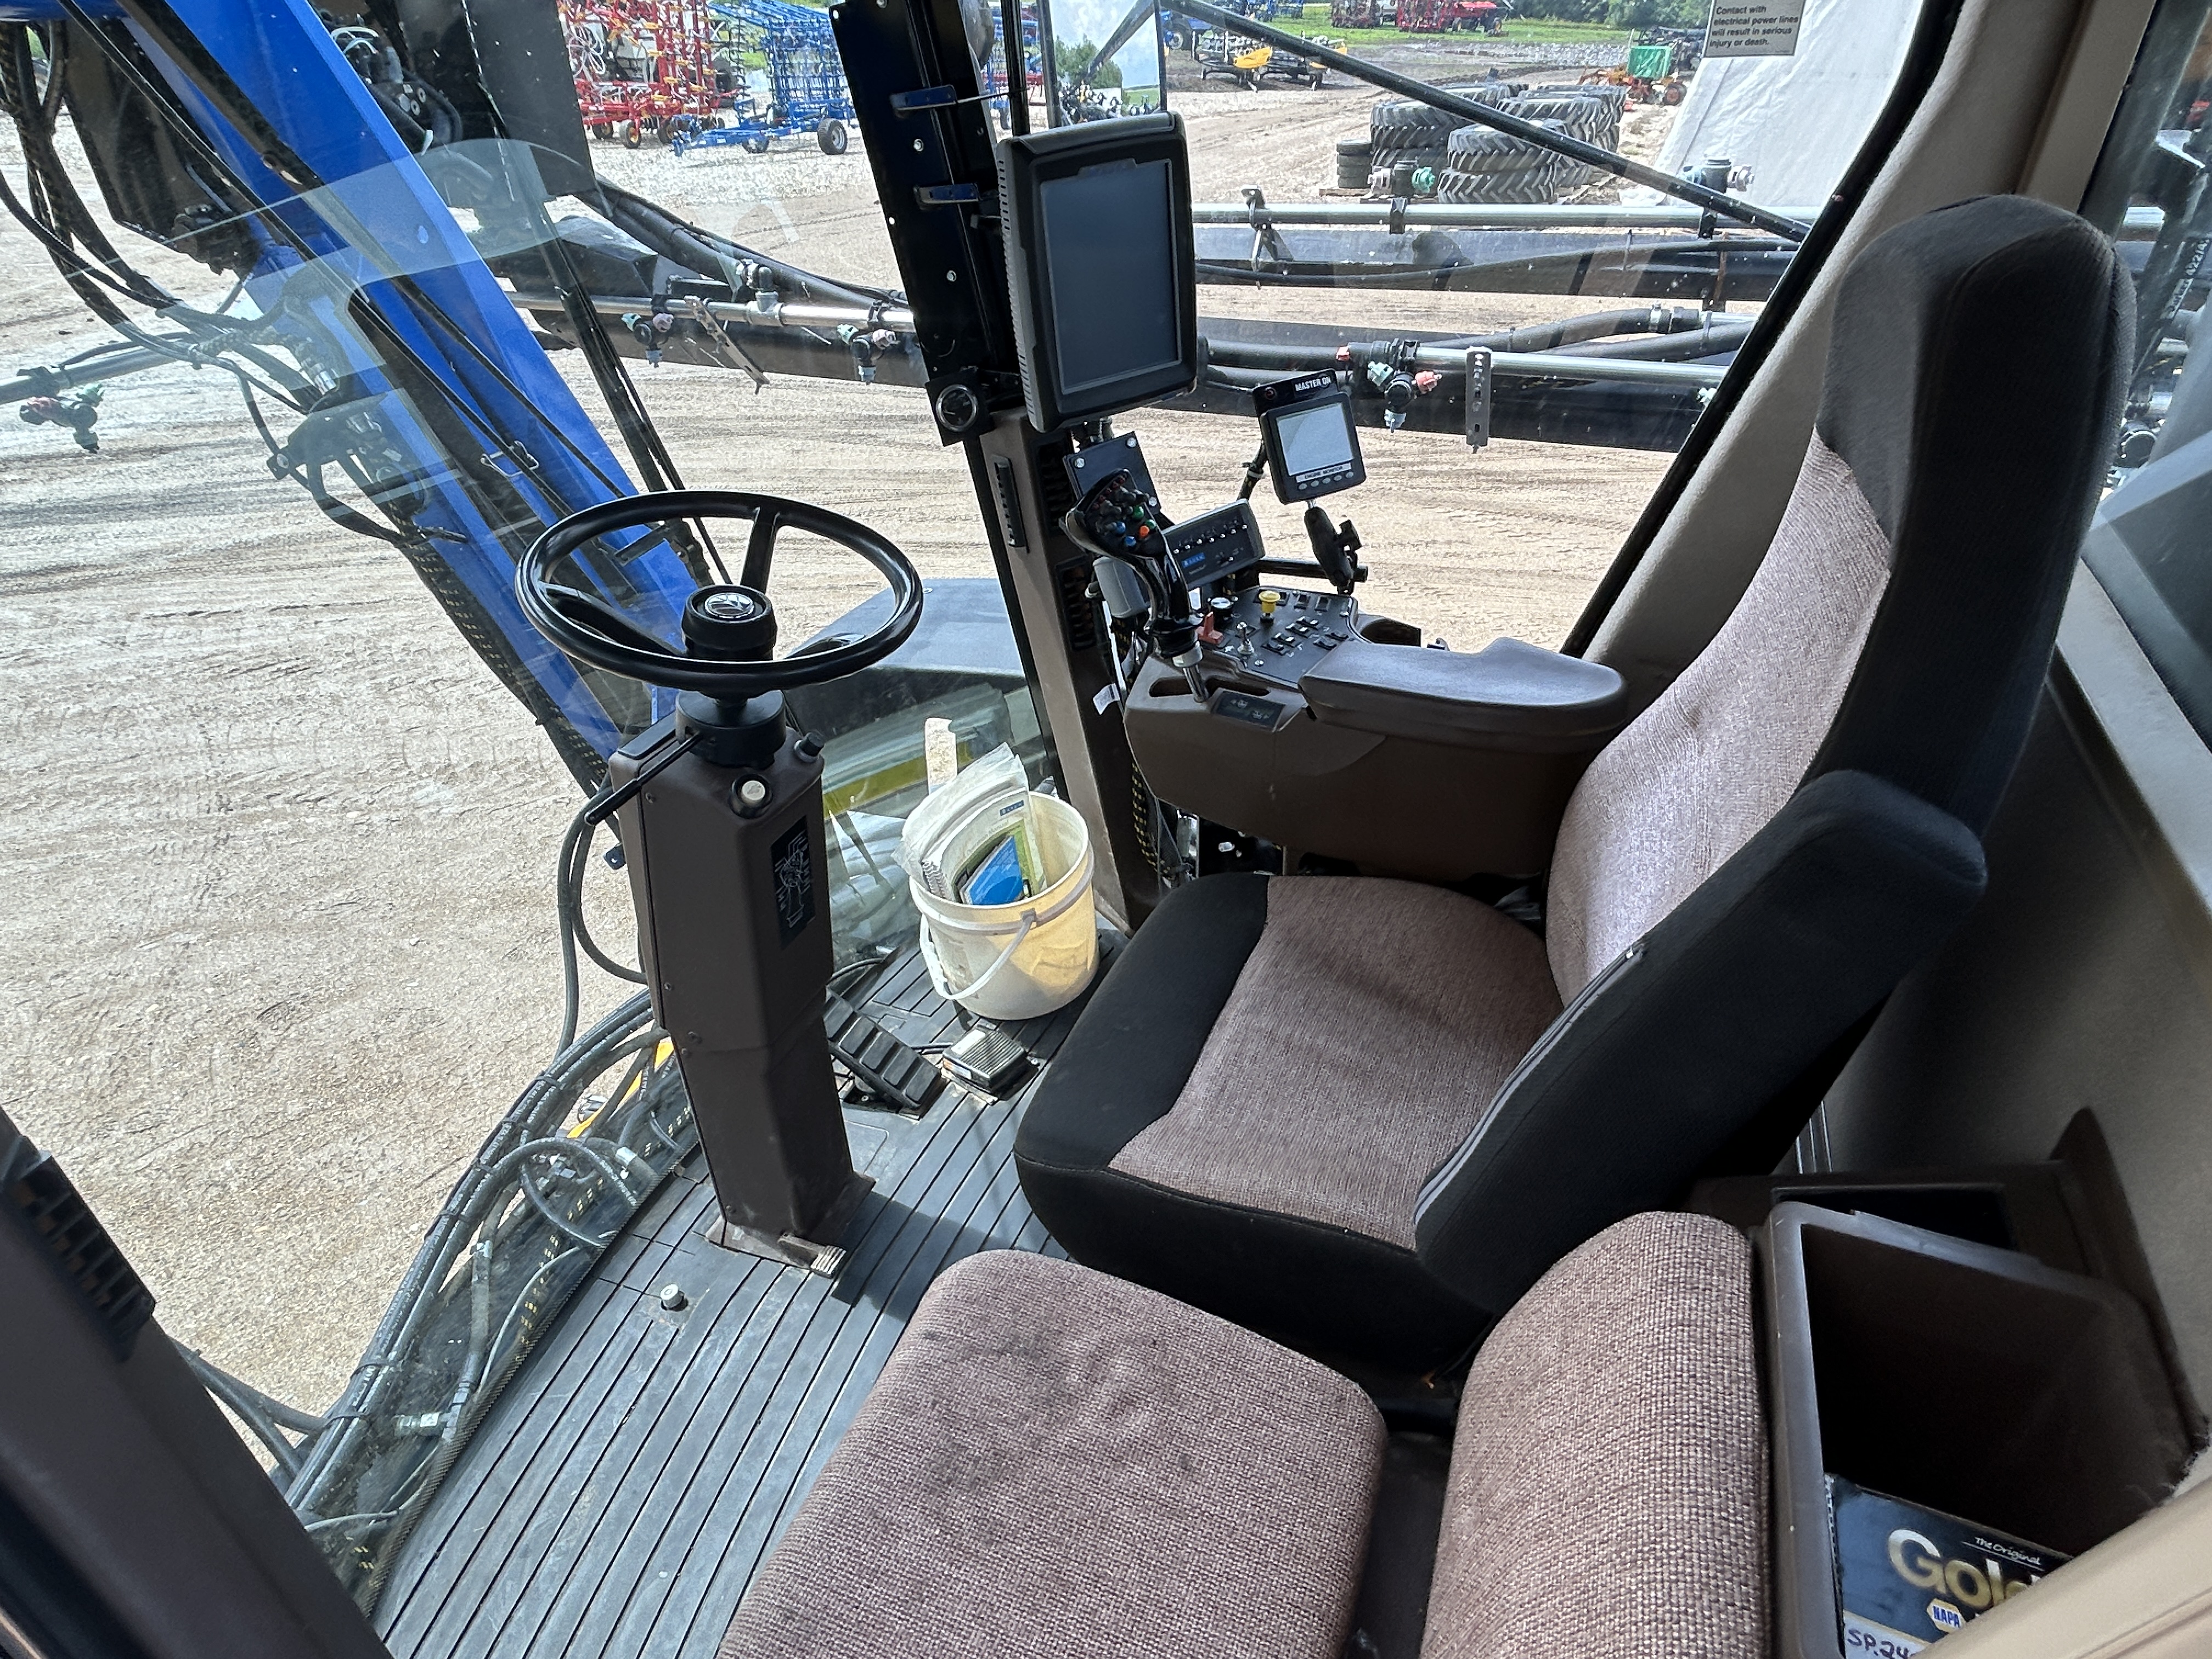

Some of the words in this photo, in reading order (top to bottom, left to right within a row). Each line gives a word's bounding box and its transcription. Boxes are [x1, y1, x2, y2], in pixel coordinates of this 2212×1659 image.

[1714, 17, 1750, 26] electrical
[1751, 16, 1778, 26] power
[1779, 15, 1798, 24] lines
[1762, 27, 1792, 35] serious
[1709, 40, 1732, 48] injury
[1745, 38, 1769, 47] death.
[1295, 379, 1322, 391] MASTER
[1322, 376, 1331, 385] ON
[1974, 1536, 1993, 1549] The
[1993, 1544, 2041, 1566] Original
[1888, 1529, 2041, 1608] Gol
[1933, 1605, 1960, 1628] NAPA
